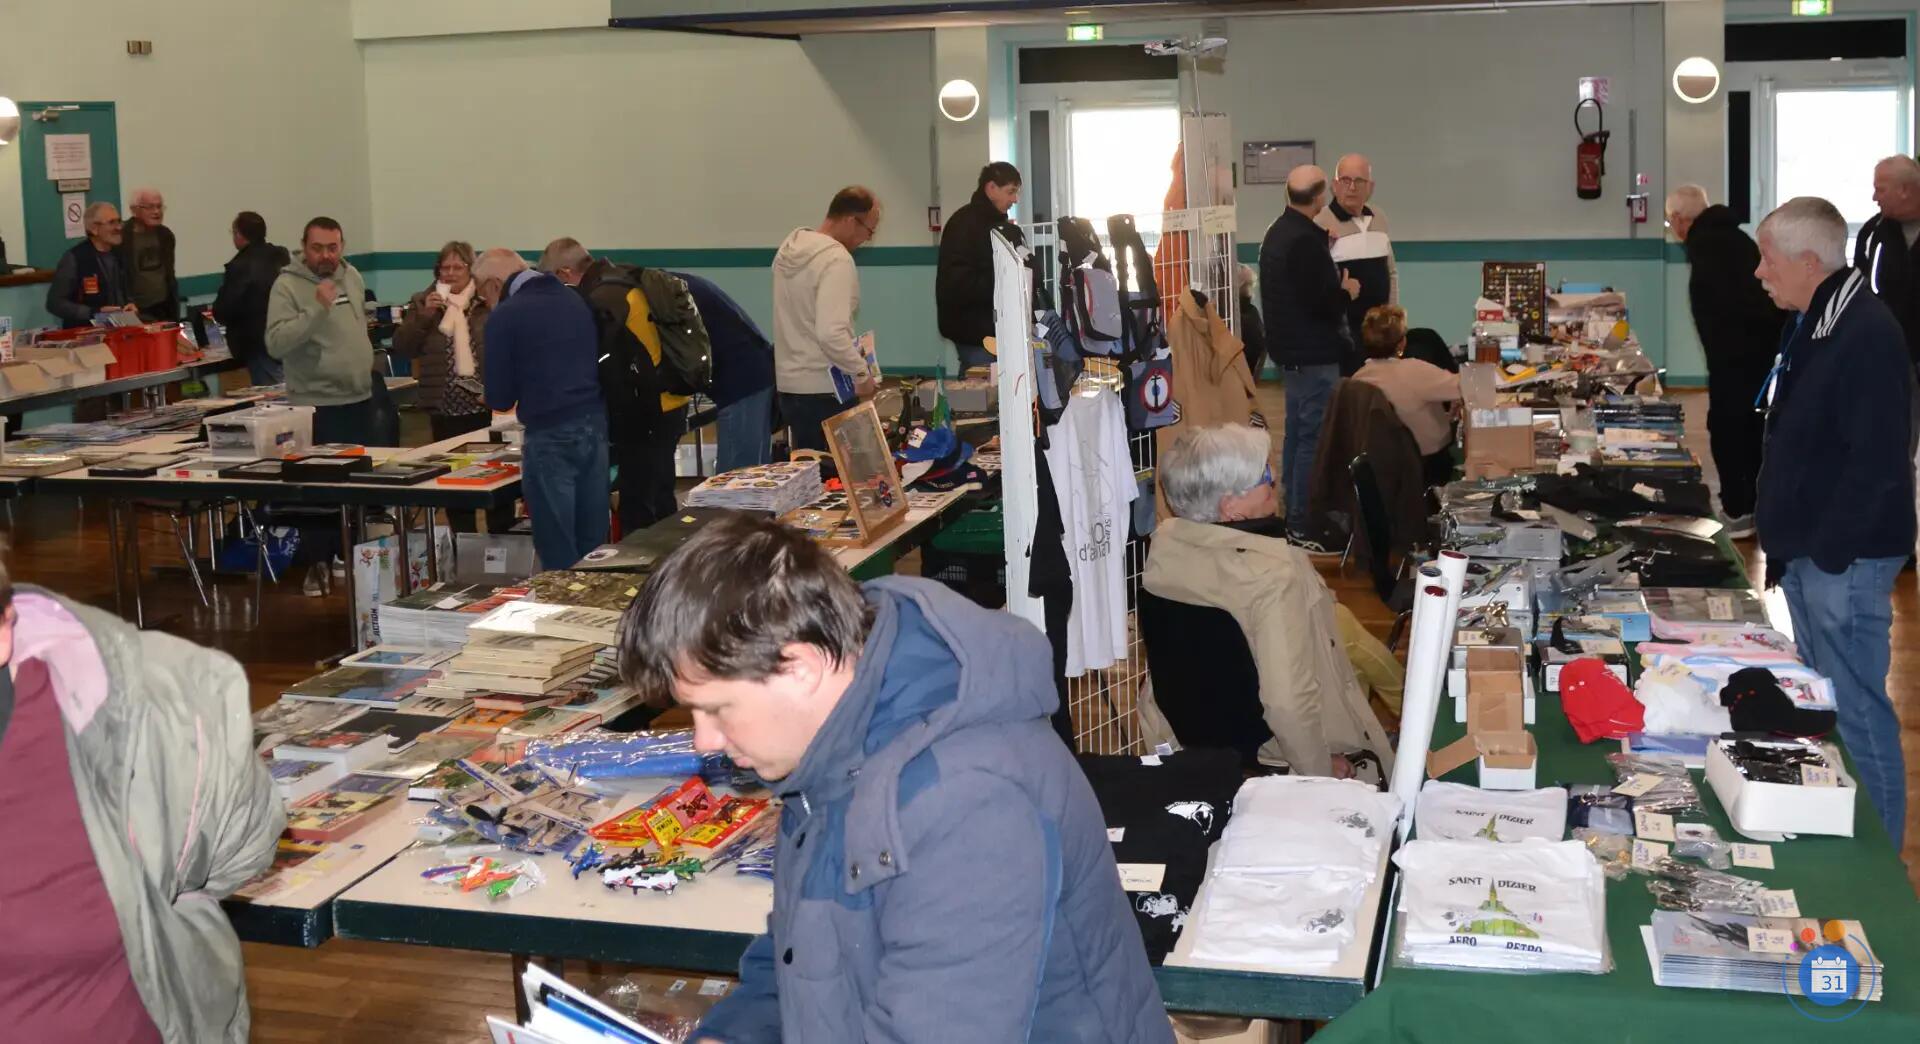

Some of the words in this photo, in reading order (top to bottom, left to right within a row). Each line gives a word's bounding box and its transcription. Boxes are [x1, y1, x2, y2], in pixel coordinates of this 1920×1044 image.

[1498, 814, 1535, 826] DIZIER
[1448, 876, 1484, 887] SAINT
[1497, 879, 1537, 893] DIZIER
